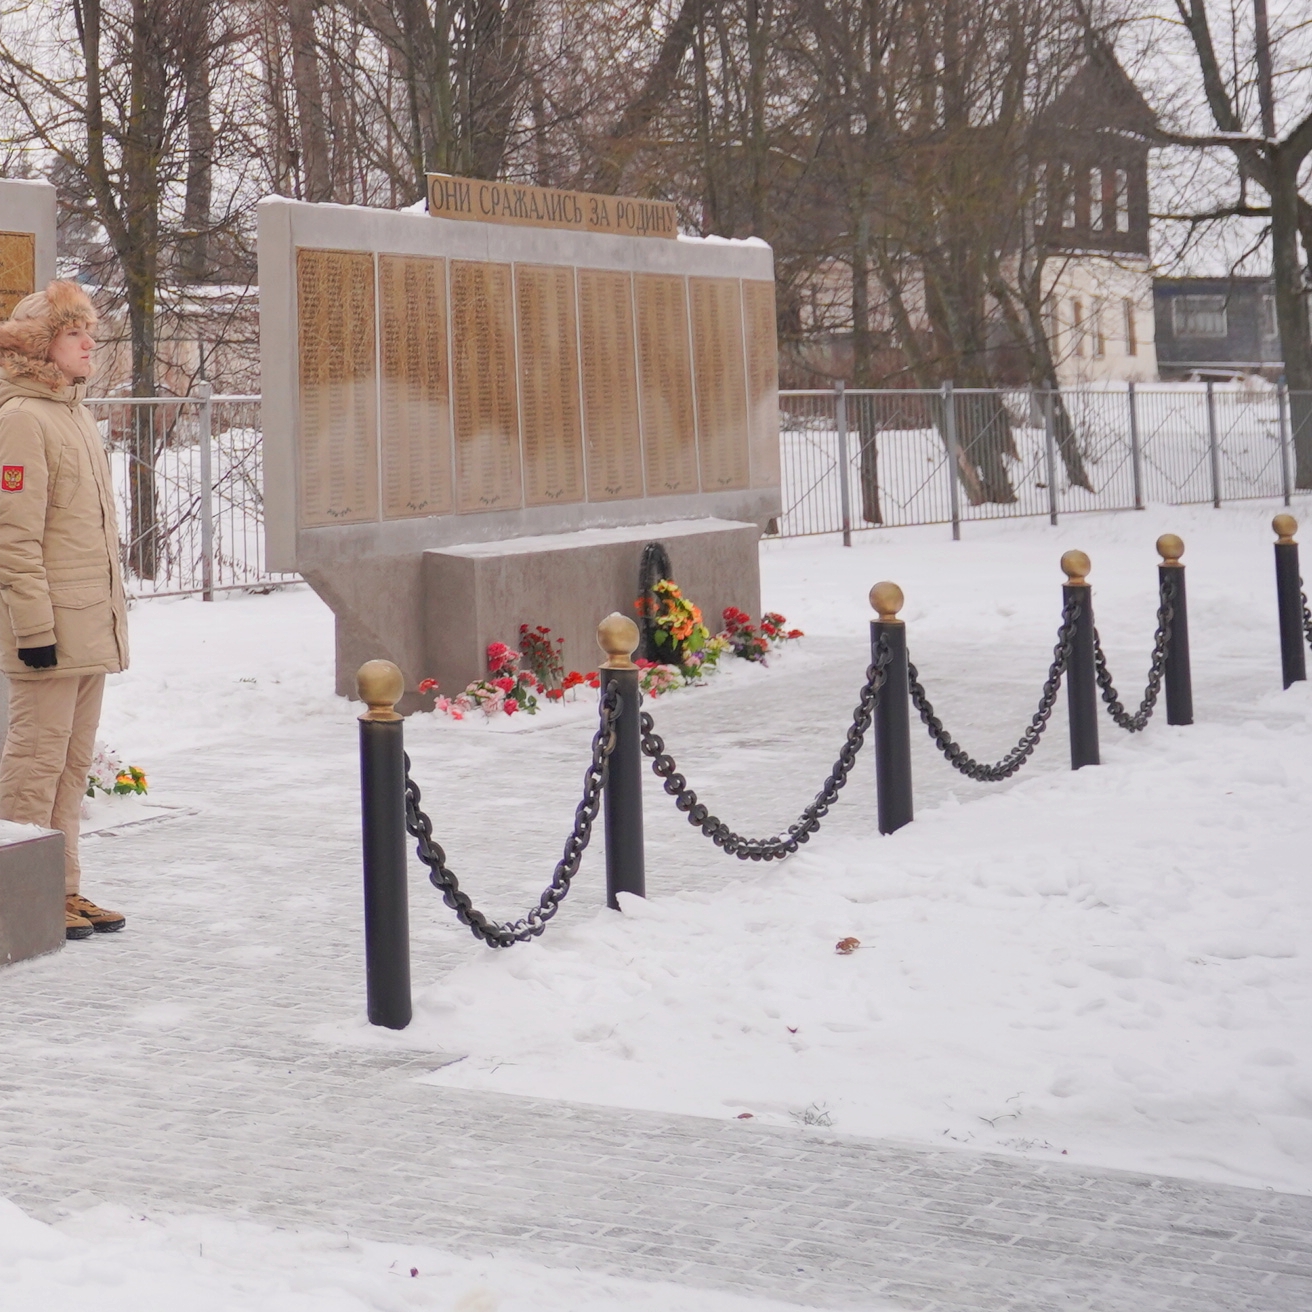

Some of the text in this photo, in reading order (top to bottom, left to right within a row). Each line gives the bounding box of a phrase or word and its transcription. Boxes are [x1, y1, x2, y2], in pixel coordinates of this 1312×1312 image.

[431, 179, 675, 235] ОНИ СРАЖАЛИСЬ ЗА РОДИНУ
